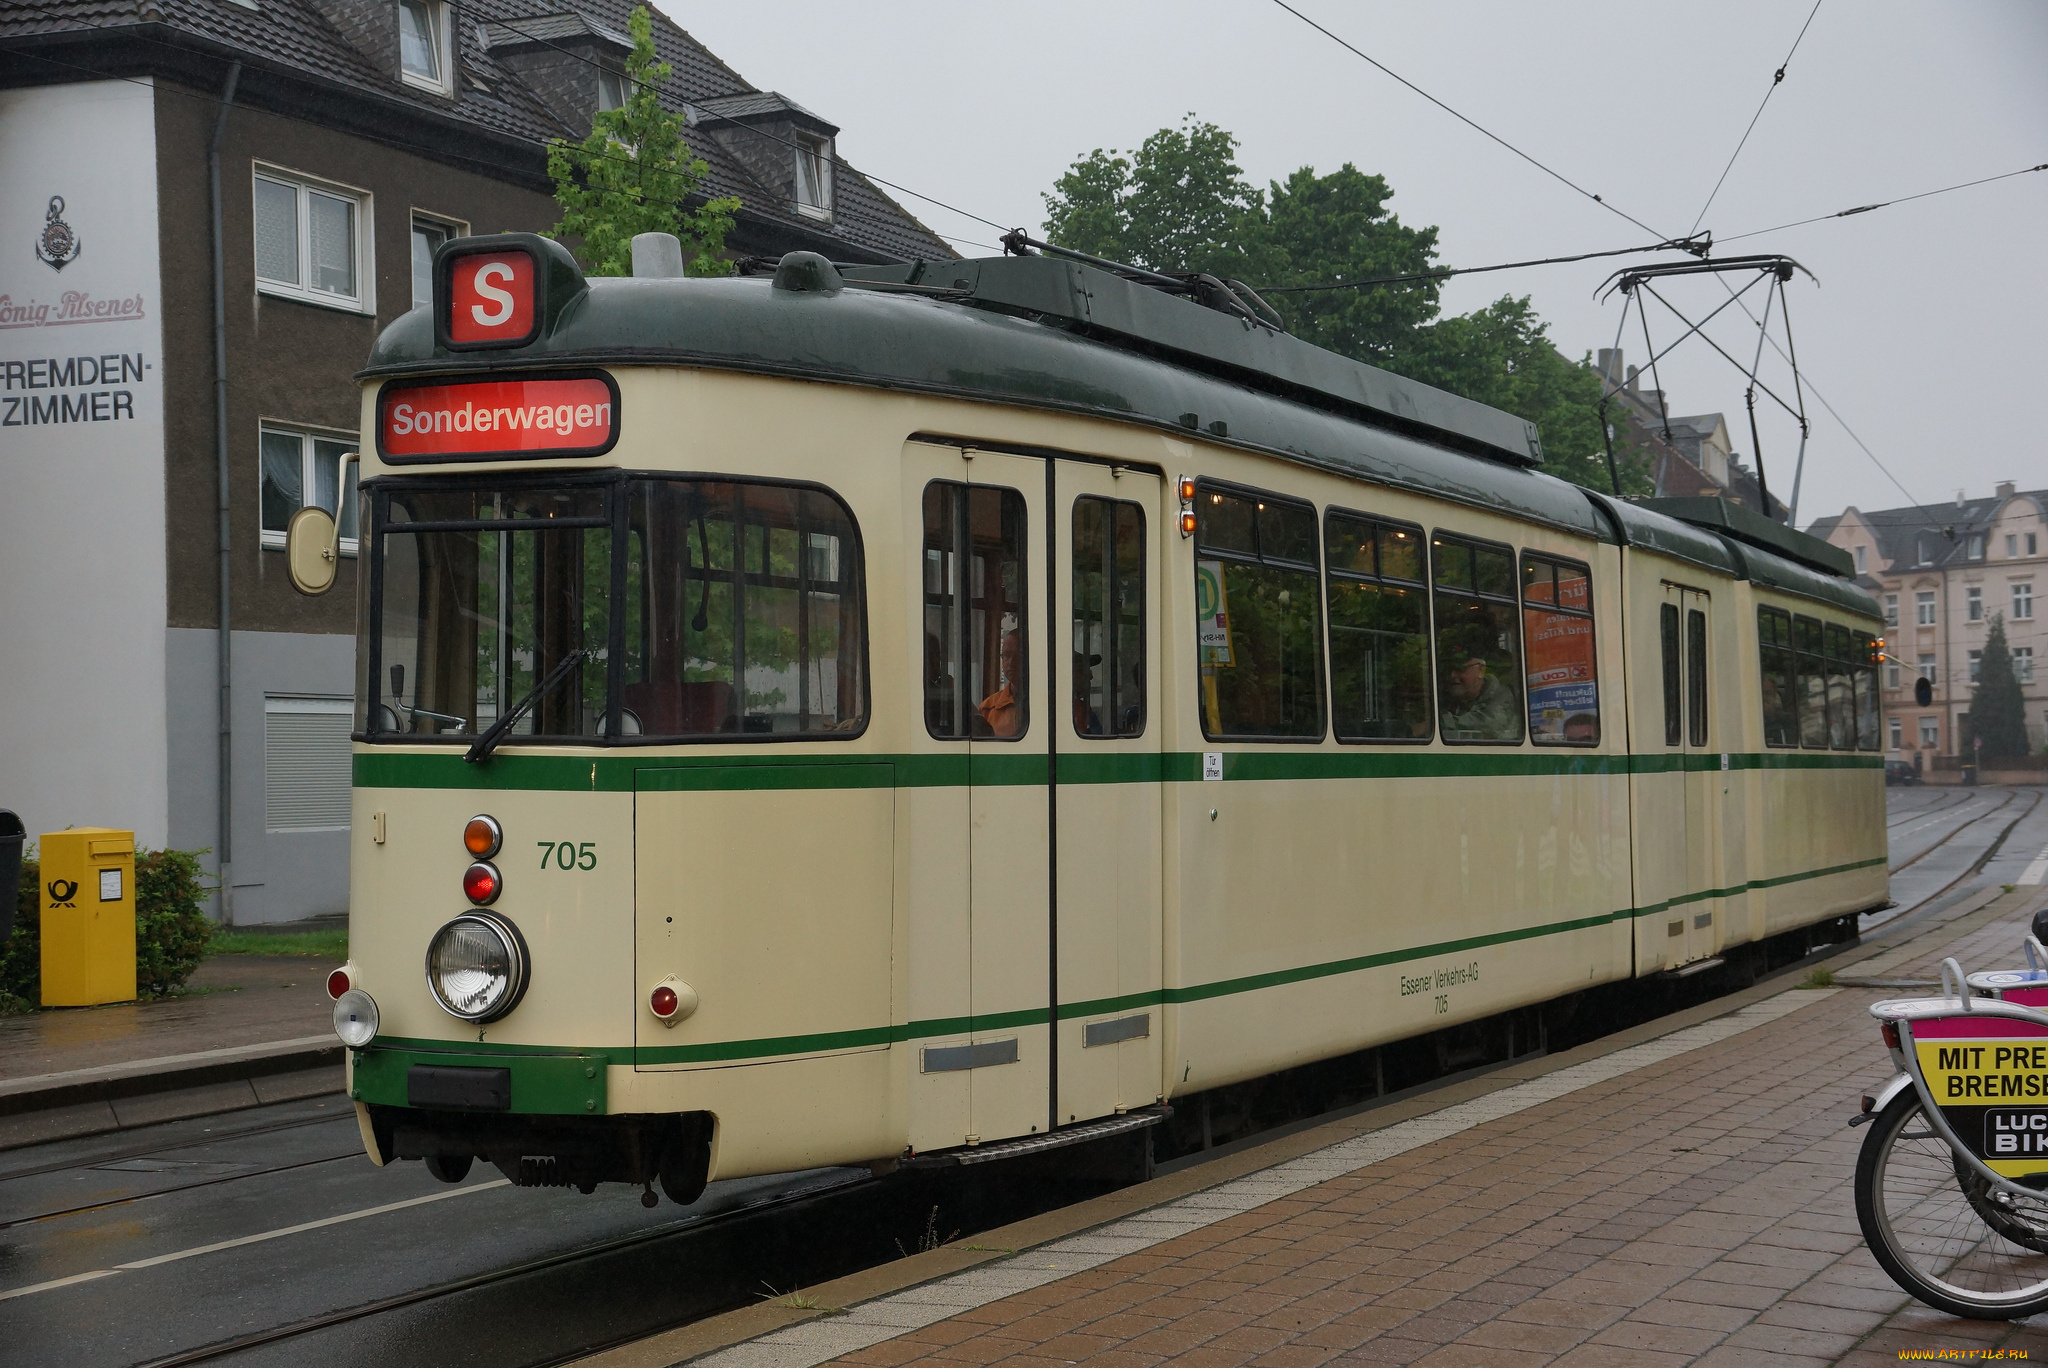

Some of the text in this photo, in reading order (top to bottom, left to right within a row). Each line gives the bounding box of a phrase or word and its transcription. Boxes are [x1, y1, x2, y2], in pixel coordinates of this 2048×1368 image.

[471, 262, 515, 327] S
[2, 389, 134, 427] ZIMMER
[392, 401, 611, 436] Sonderwagen
[537, 841, 598, 871] 705
[1400, 961, 1479, 997] Essener Verkehrs-AG
[1434, 994, 1448, 1015] 705
[1938, 1046, 2047, 1070] MIT PRE
[1995, 1114, 2047, 1131] LUC
